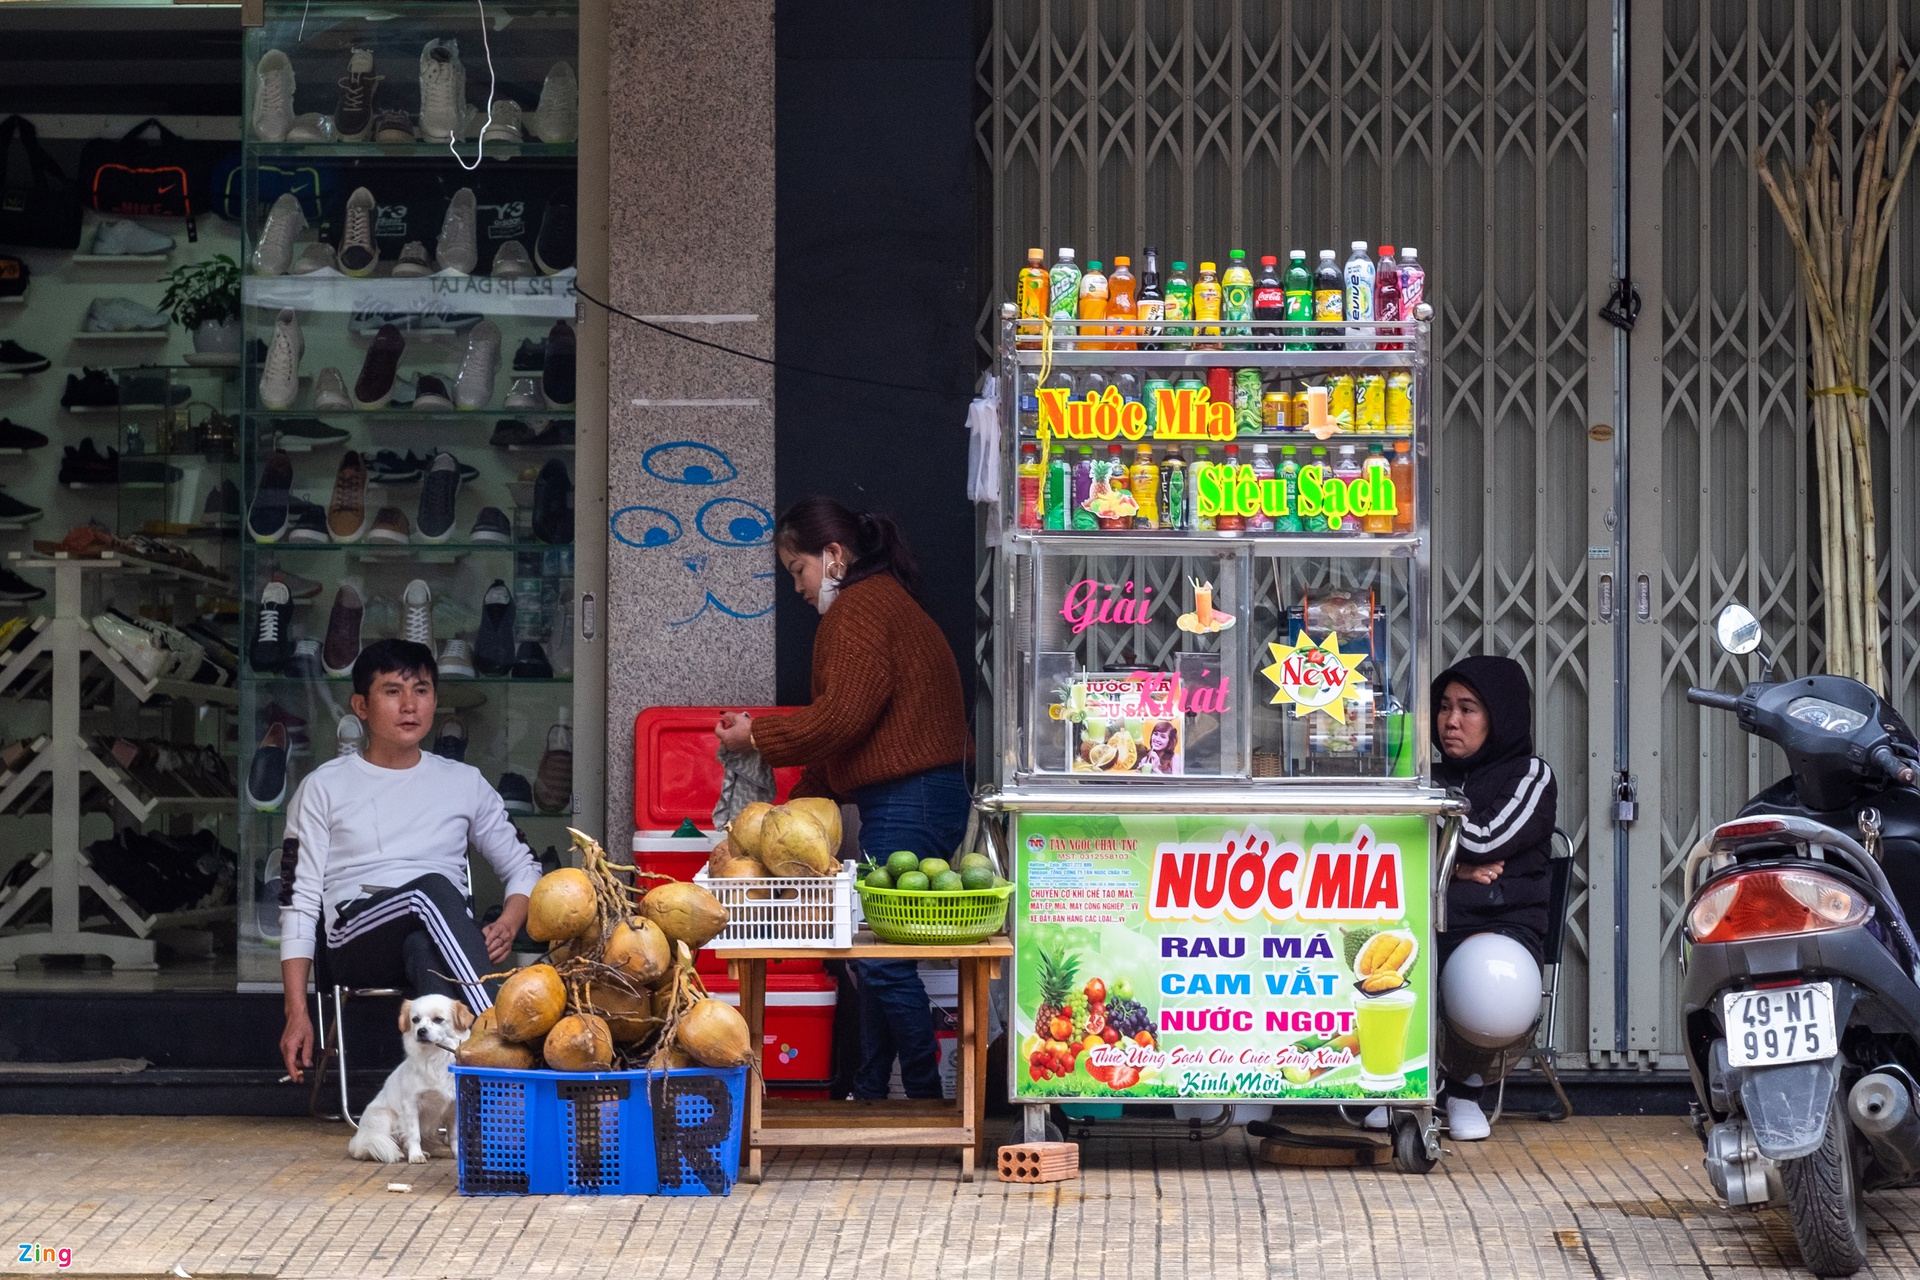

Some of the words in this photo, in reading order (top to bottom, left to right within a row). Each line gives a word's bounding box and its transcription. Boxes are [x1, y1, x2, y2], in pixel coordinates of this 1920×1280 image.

[1035, 385, 1148, 440] Nước
[1153, 386, 1237, 441] Mía
[1197, 463, 1289, 517] Siêu
[1298, 464, 1398, 530] Sạch
[1059, 579, 1153, 634] Giải
[1282, 656, 1349, 687] New
[1126, 669, 1231, 714] Khát
[1121, 839, 1138, 850] TNC
[1155, 834, 1299, 910] NƯỚC
[1305, 834, 1399, 909] MÍA
[1030, 888, 1059, 898] CHUYÊN
[1061, 889, 1071, 898] CƠ
[1069, 902, 1082, 910] MÁY
[1084, 902, 1101, 910] CÔNG
[1161, 937, 1246, 958] RAU
[1262, 933, 1334, 958] MÁ
[1161, 973, 1250, 995] CAM
[1265, 966, 1339, 996] VẮT
[1161, 1006, 1253, 1031] NƯỚC
[1266, 1011, 1355, 1037] NGỌT
[1742, 990, 1816, 1028] 49-N1
[1744, 1023, 1820, 1060] 9975
[1171, 1047, 1204, 1067] Sạch
[1208, 1048, 1235, 1064] Cho
[1239, 1048, 1271, 1068] Cuộc
[1276, 1048, 1310, 1070] Sống
[1314, 1048, 1351, 1066] Xanh
[1181, 1072, 1230, 1093] Kính
[1235, 1072, 1281, 1092] Mời
